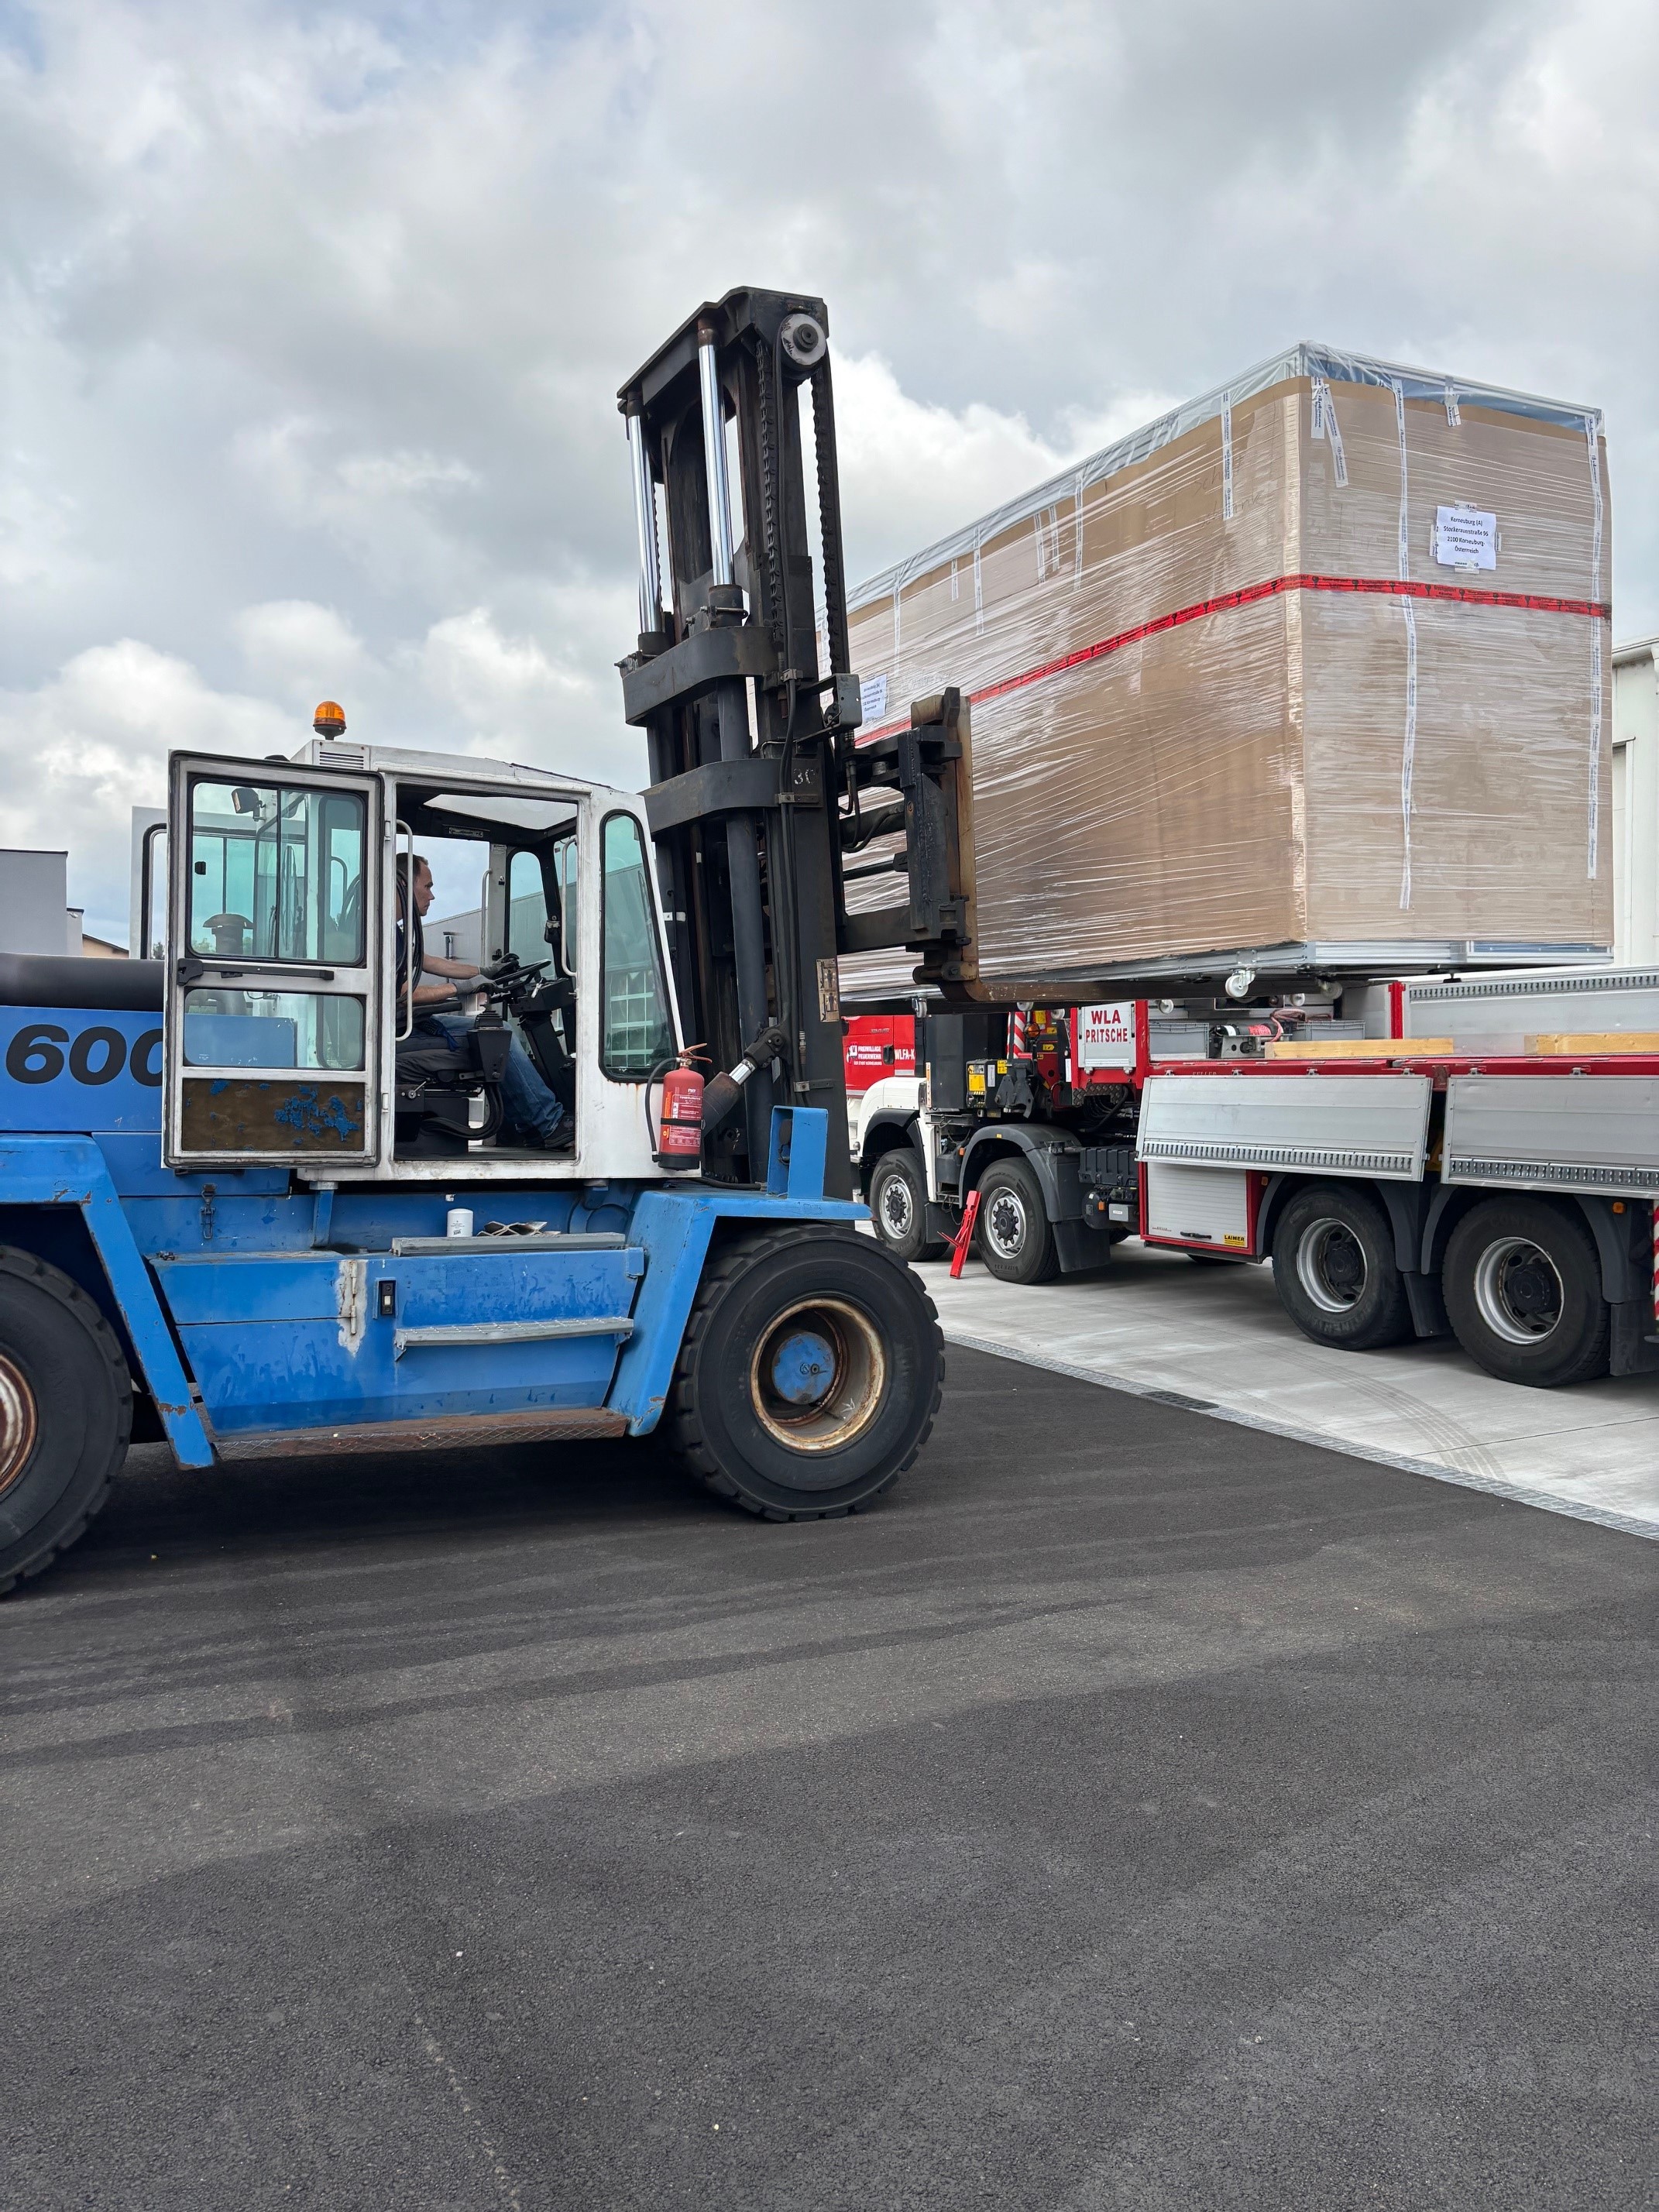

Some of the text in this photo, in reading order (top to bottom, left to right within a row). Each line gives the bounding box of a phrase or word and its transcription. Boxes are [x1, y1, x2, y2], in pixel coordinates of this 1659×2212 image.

[1450, 516, 1475, 527] Korneuburg
[1455, 545, 1479, 554] Österreich
[1091, 1009, 1121, 1025] WLA
[1085, 1028, 1128, 1042] PRITSCHE
